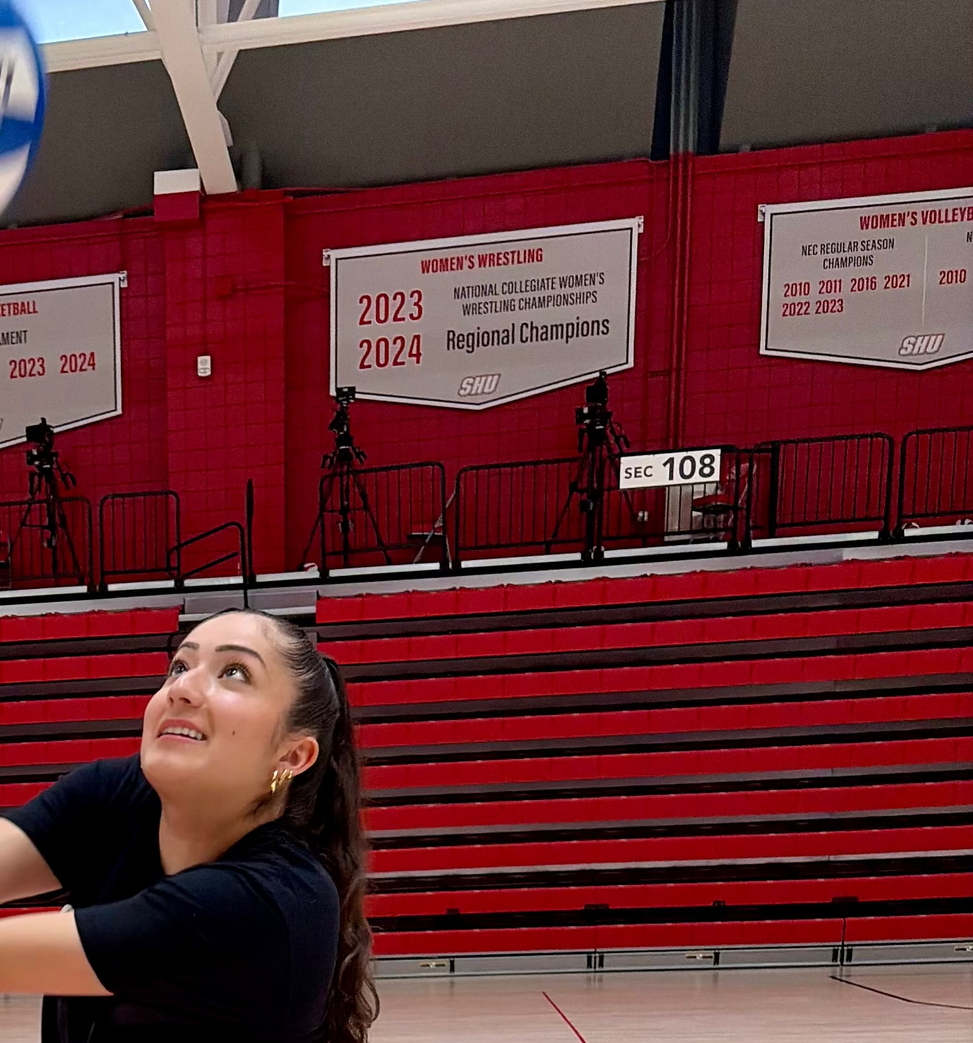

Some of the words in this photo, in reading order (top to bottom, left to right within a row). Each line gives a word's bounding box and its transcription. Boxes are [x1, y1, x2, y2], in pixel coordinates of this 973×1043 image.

[860, 211, 917, 231] WOMEN'S
[801, 244, 818, 257] NEC
[820, 240, 859, 255] REGULAR
[860, 237, 895, 251] SEASON
[420, 254, 475, 274] WOMEN'S
[478, 248, 543, 268] WRESTLING
[822, 254, 874, 270] CHAMPIONS
[453, 283, 499, 300] NATIONAL
[501, 276, 556, 295] COLLEGIATE
[558, 272, 605, 289] WOMEN'S
[783, 281, 811, 298] 2010
[818, 279, 842, 295] 2011
[850, 276, 877, 293] 2016
[884, 273, 911, 290] 2021
[939, 268, 967, 285] 2010
[358, 289, 424, 326] 2023
[462, 299, 516, 317] WRESTLING
[518, 290, 598, 311] CHAMPIONSHIPS
[782, 301, 810, 318] 2022
[815, 298, 844, 315] 2023
[446, 323, 515, 354] Regional
[519, 316, 610, 344] Champions
[899, 333, 946, 357] SHU
[358, 334, 423, 370] 2024
[9, 357, 46, 379] 2023
[60, 352, 96, 374] 2024
[457, 373, 501, 398] SHU
[624, 465, 653, 480] SEC
[662, 453, 715, 481] 108
